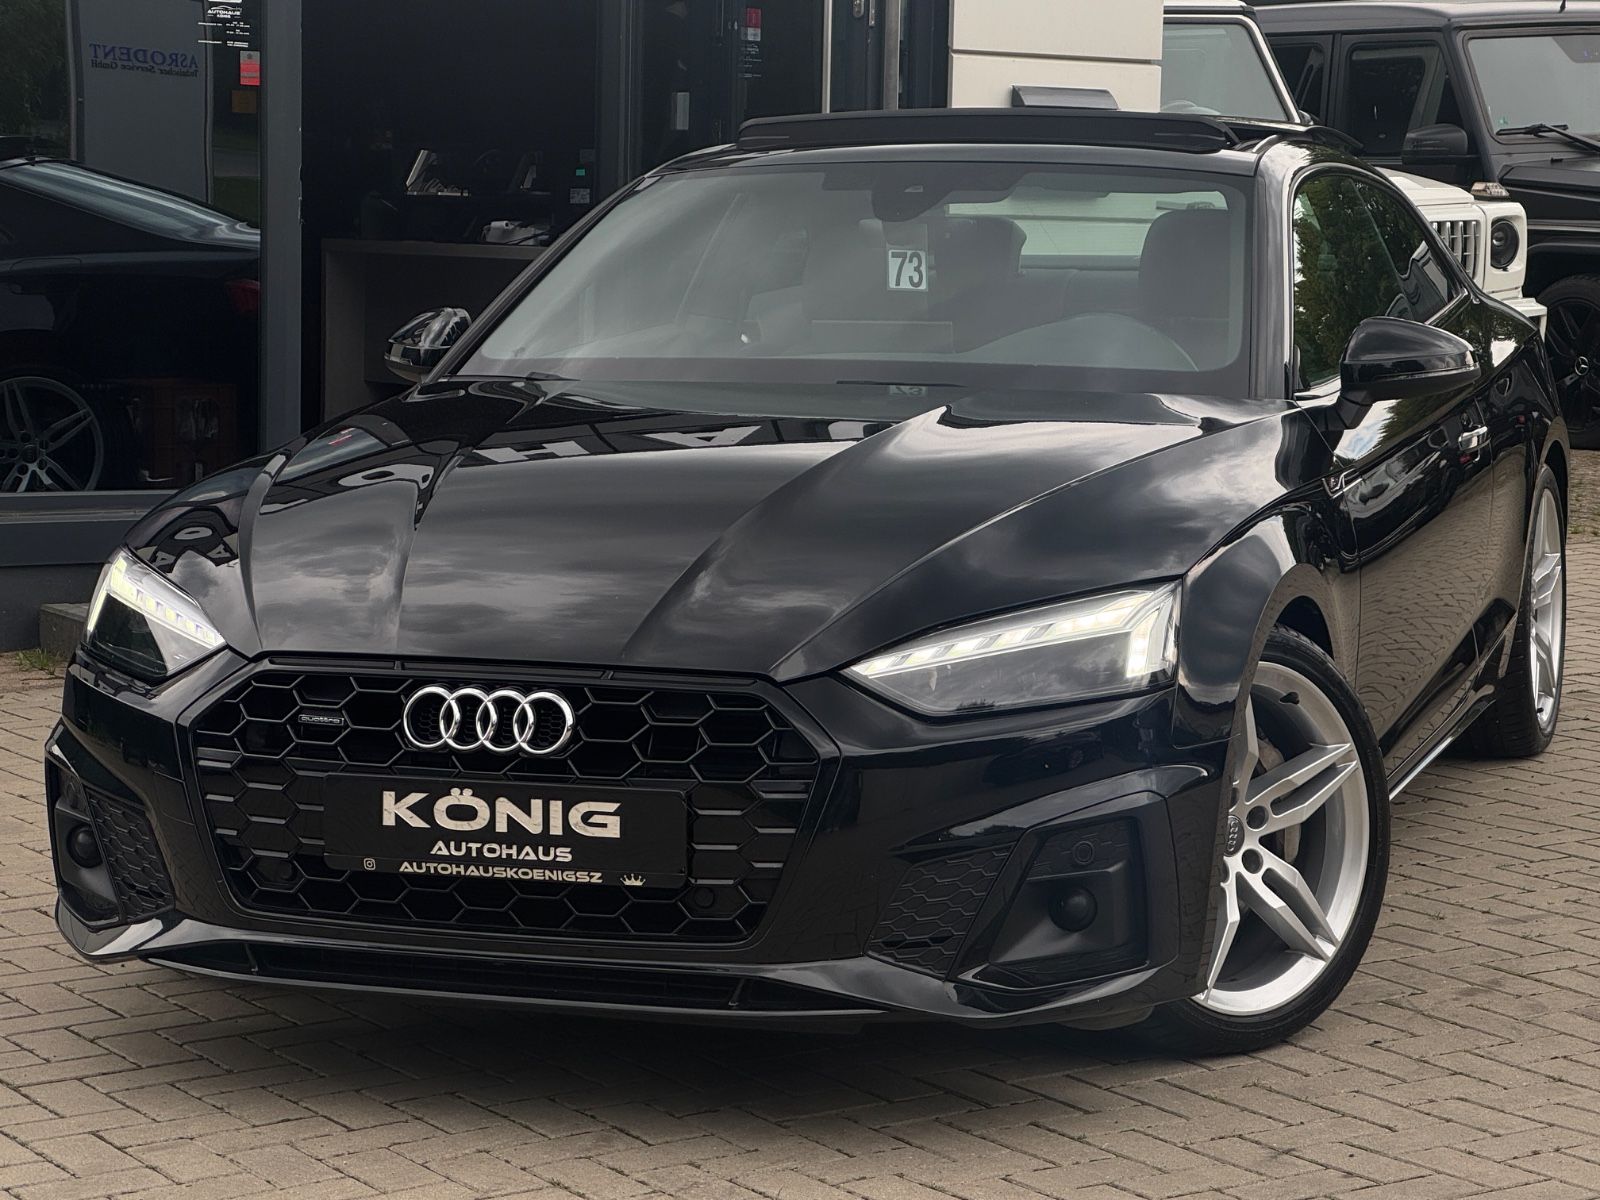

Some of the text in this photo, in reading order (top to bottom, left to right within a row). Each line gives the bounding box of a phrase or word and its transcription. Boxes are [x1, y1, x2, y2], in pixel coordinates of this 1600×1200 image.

[891, 251, 924, 288] 73
[382, 787, 622, 838] KÖNIG
[430, 840, 573, 862] AUTOHAUS
[399, 861, 604, 883] AUTOHAUSKOENIGSZ
